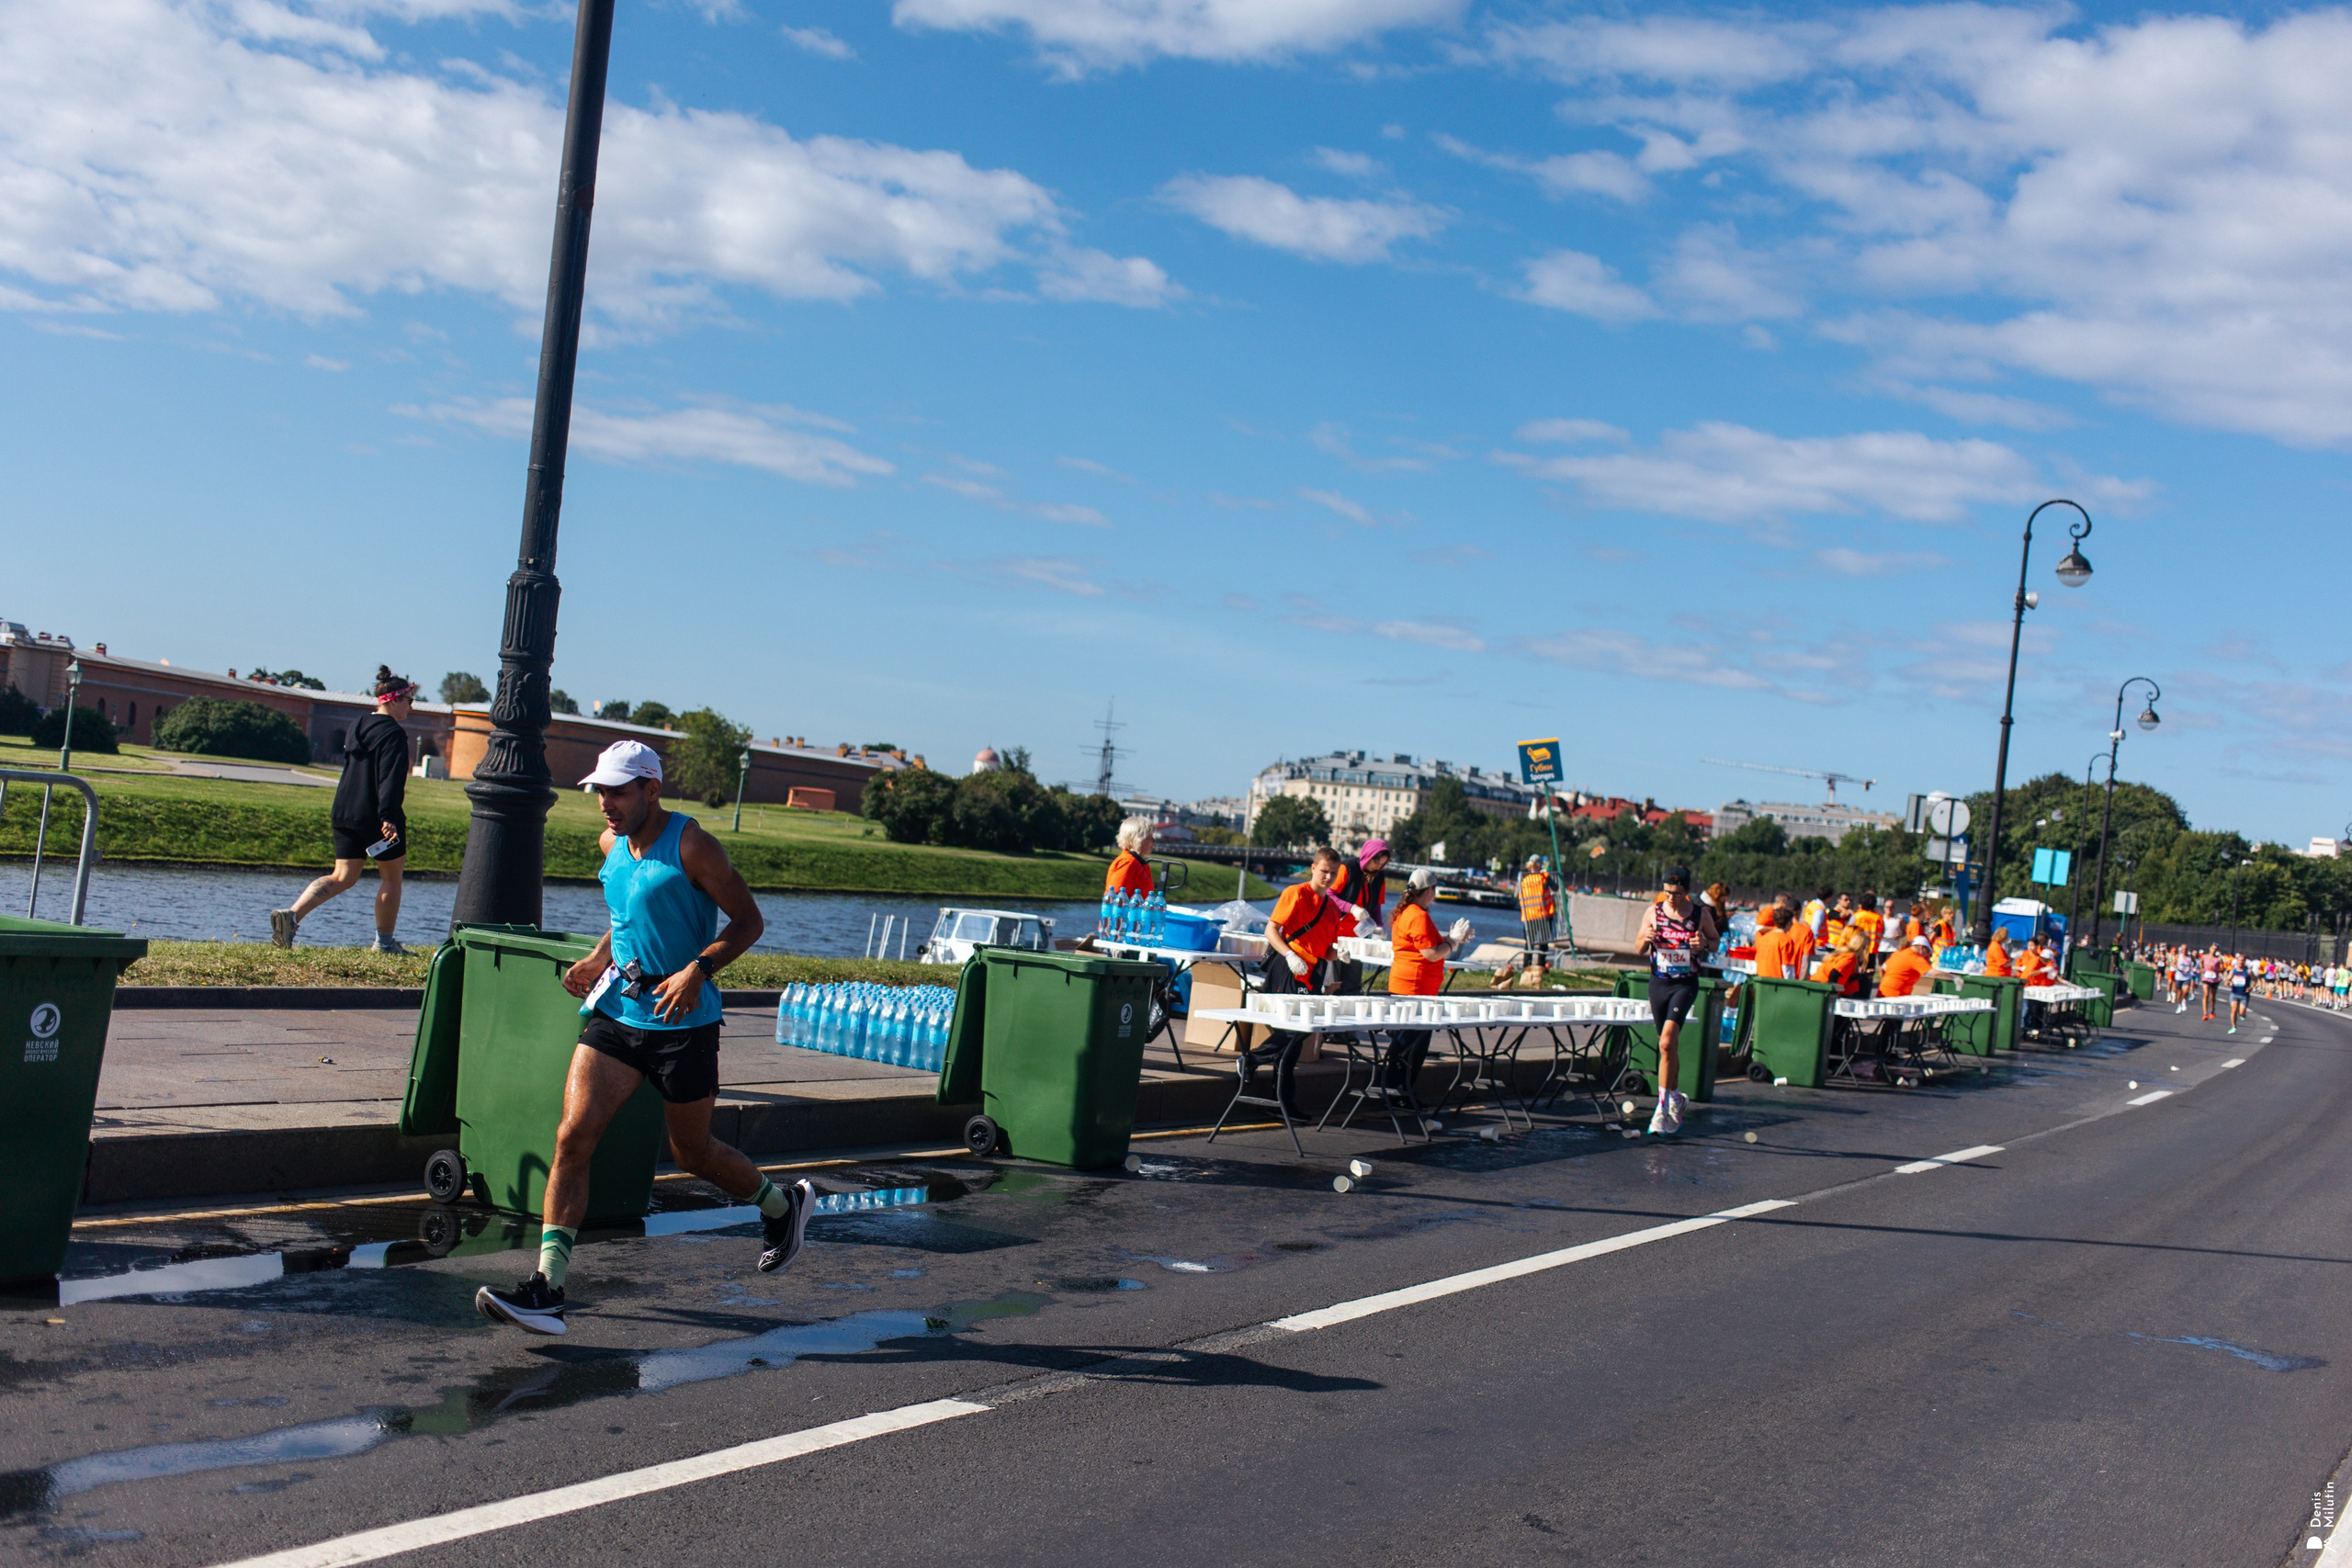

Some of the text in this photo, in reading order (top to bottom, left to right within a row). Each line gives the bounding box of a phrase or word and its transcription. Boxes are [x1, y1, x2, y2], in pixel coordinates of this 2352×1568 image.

[1529, 763, 1554, 773] Губки
[1530, 773, 1555, 782] Sponges
[1661, 953, 1686, 963] 7134
[25, 1039, 59, 1049] НЕВСКИЙ
[24, 1054, 57, 1062] ОПЕРАТОР
